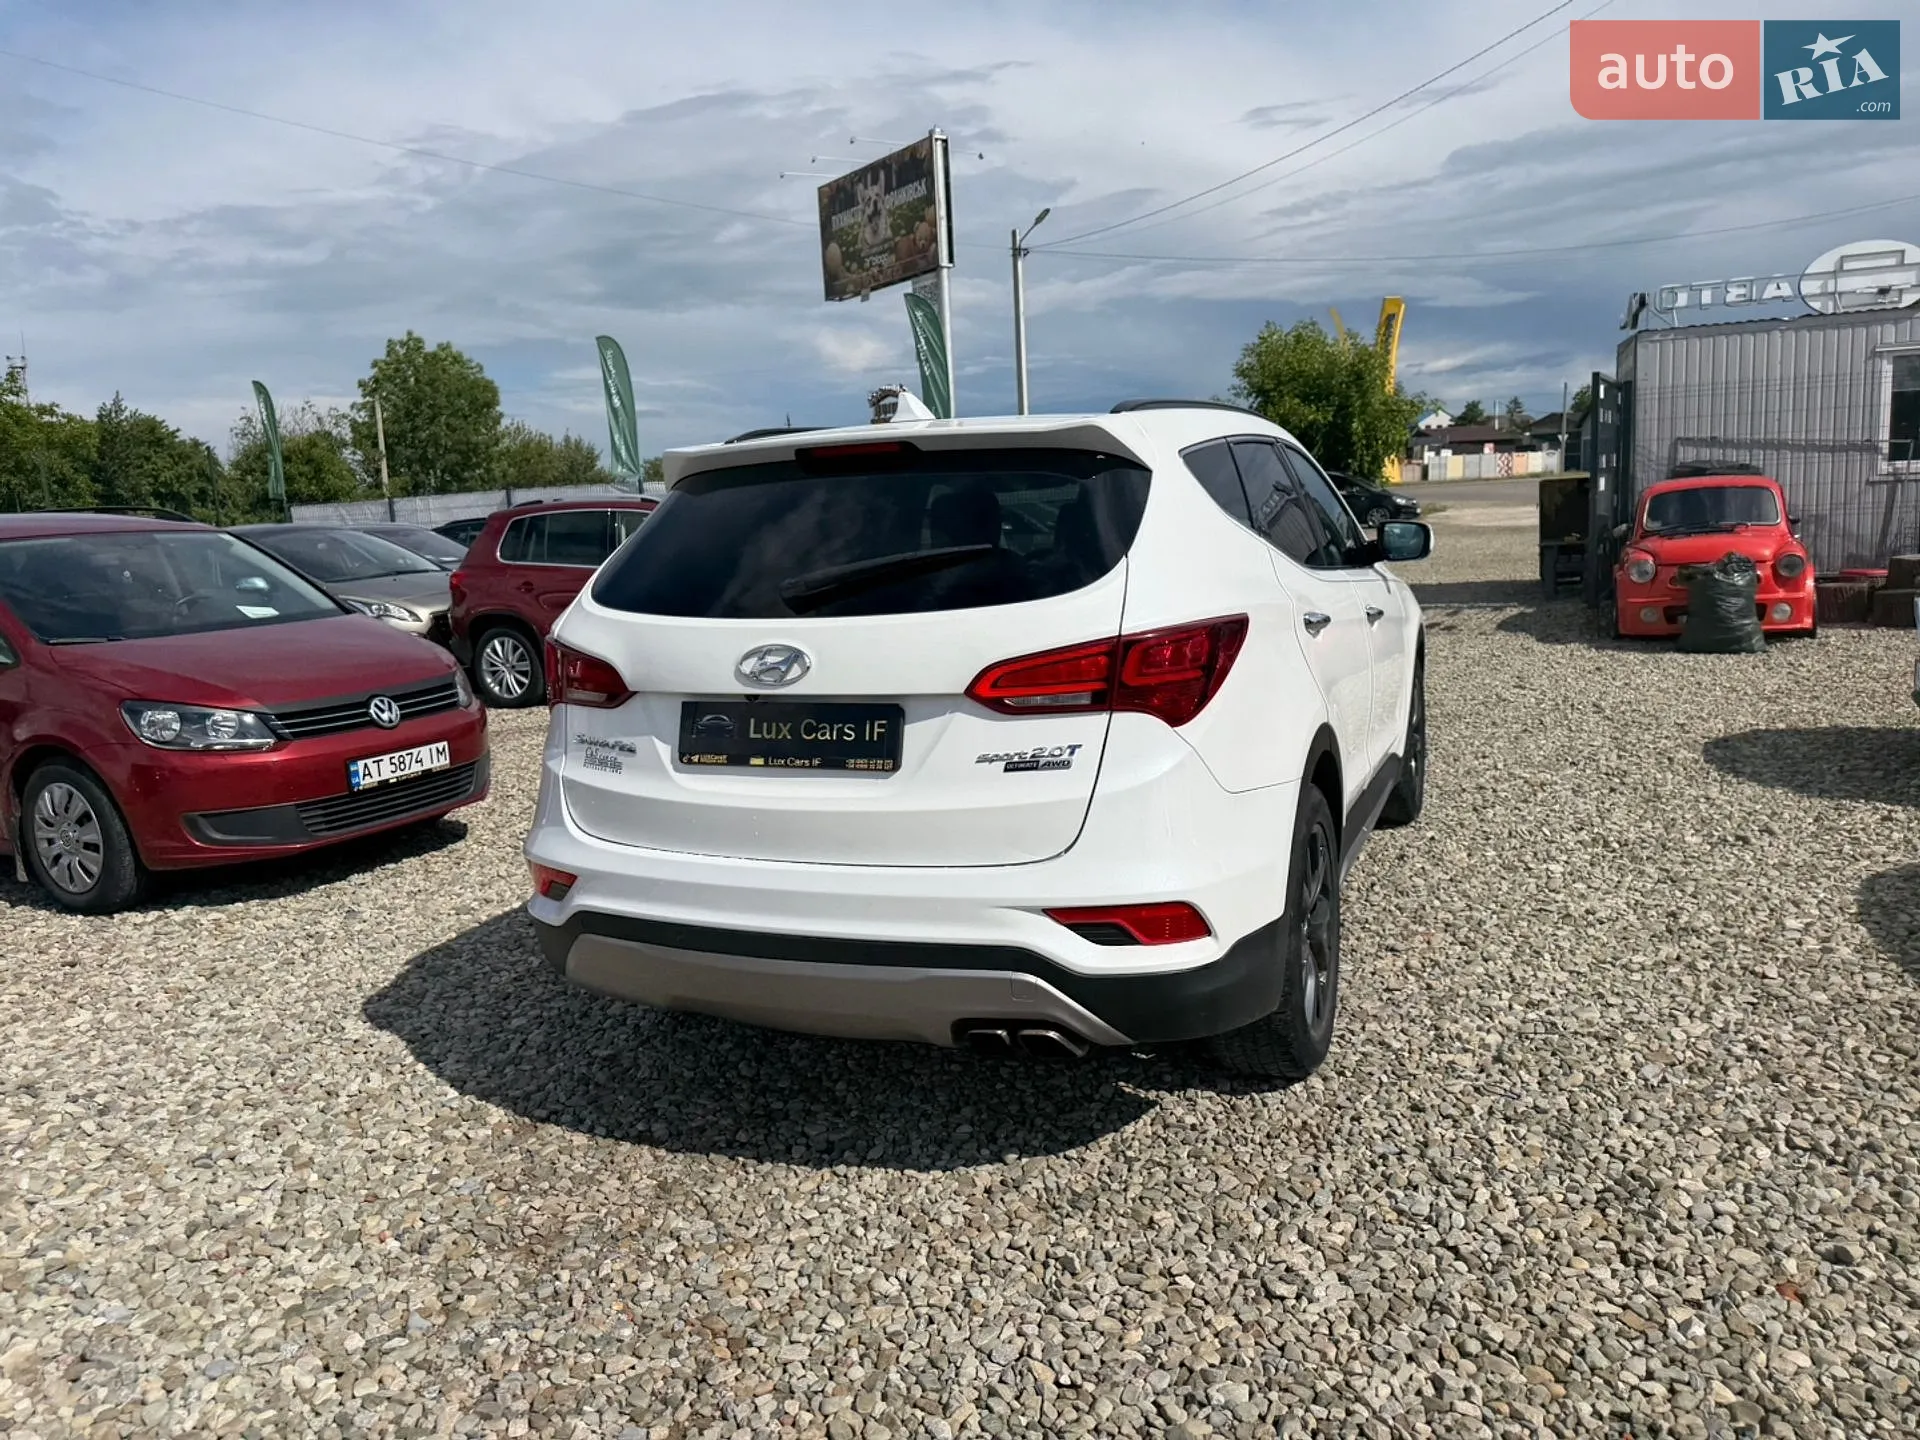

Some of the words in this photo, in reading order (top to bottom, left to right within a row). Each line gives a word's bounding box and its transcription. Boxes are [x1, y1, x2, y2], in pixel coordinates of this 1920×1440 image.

[749, 717, 792, 740] Lux
[800, 718, 857, 742] Cars
[865, 720, 888, 742] IF
[1030, 744, 1083, 759] 2.0T
[362, 758, 385, 781] AT
[389, 750, 424, 774] 5874
[429, 744, 448, 765] IM
[1040, 759, 1071, 769] AWD
